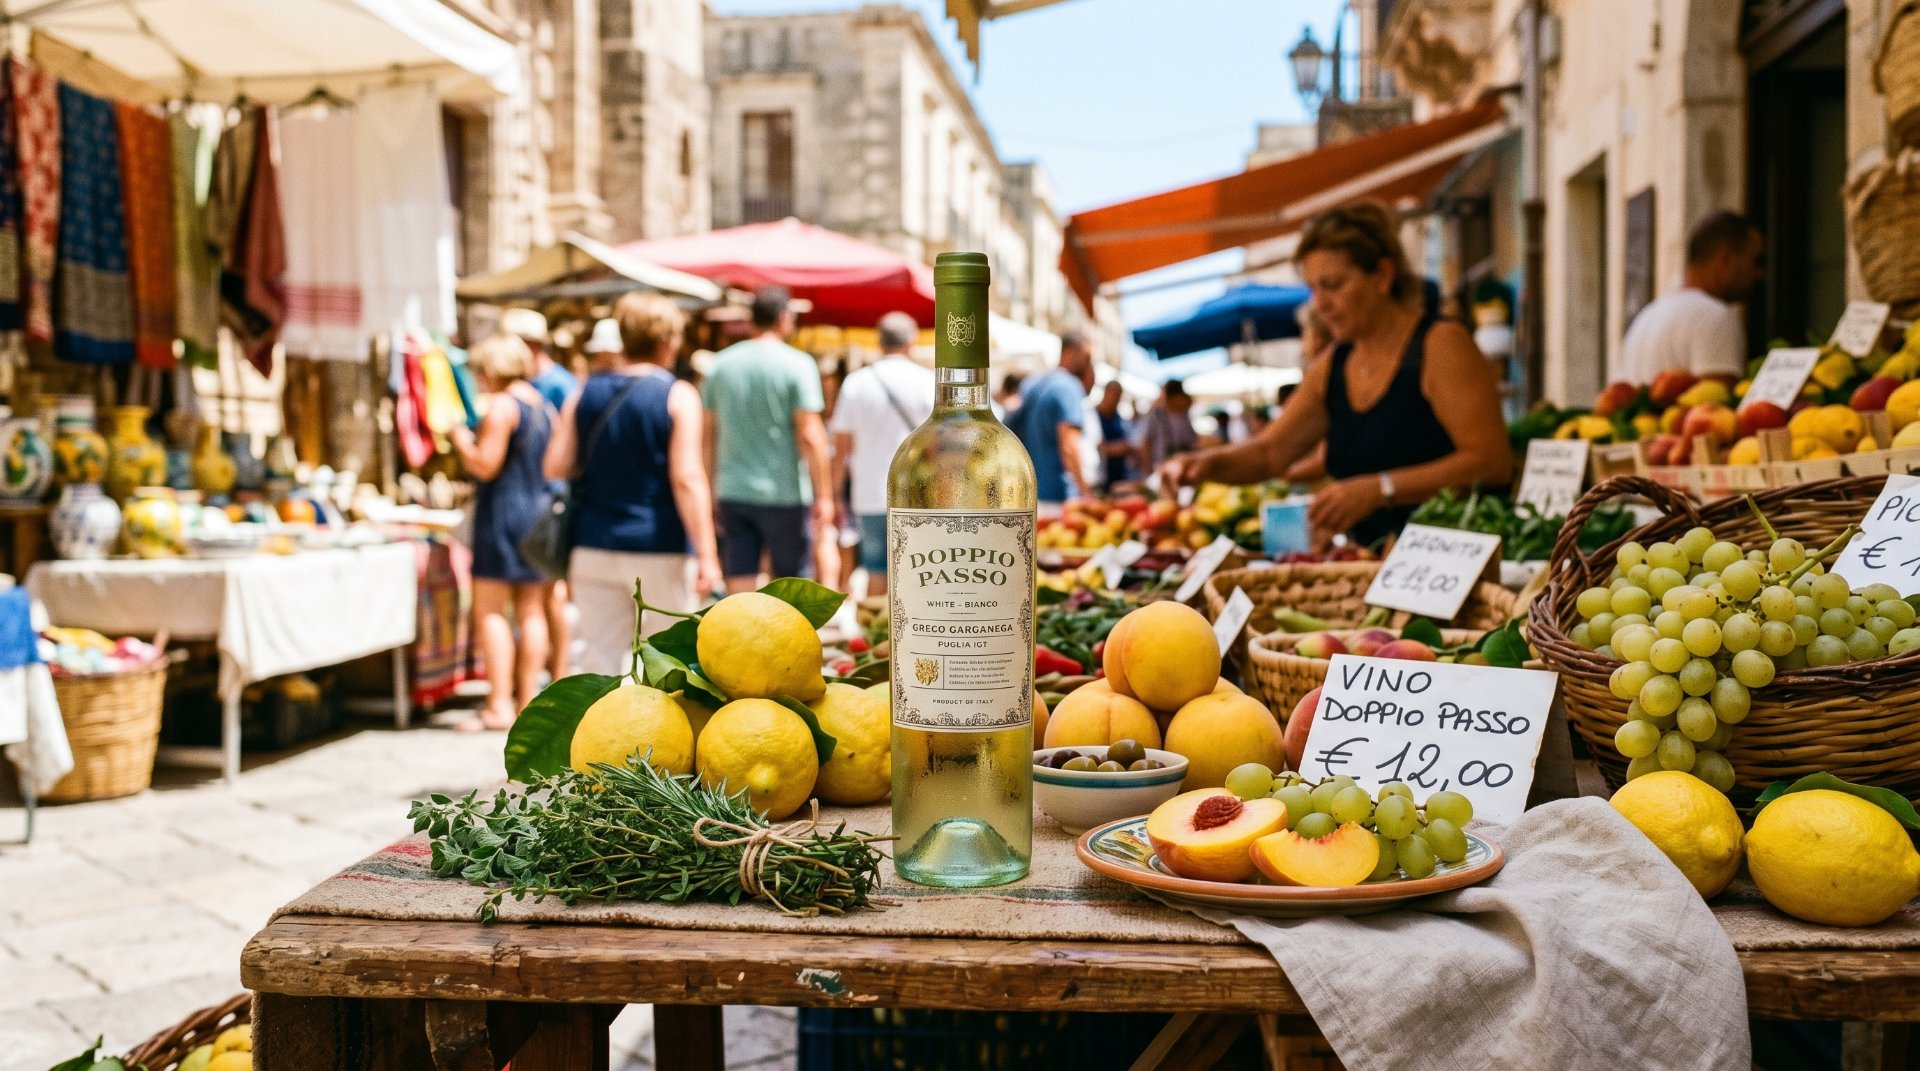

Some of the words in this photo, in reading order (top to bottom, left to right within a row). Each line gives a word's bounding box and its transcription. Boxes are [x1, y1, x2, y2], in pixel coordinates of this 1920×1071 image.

[909, 547, 1015, 569] DOPPIO
[1858, 536, 1902, 569] €
[917, 567, 1007, 588] PASSO
[927, 600, 955, 608] WHITE
[964, 600, 998, 608] BIANCO
[912, 623, 946, 634] GRECO
[949, 624, 1013, 634] GARGANEGA
[1343, 662, 1432, 694] VINO
[1322, 697, 1424, 726] DOPPIO
[1438, 702, 1531, 735] PASSO
[1315, 737, 1370, 780] €
[1375, 741, 1514, 792] 12,00
